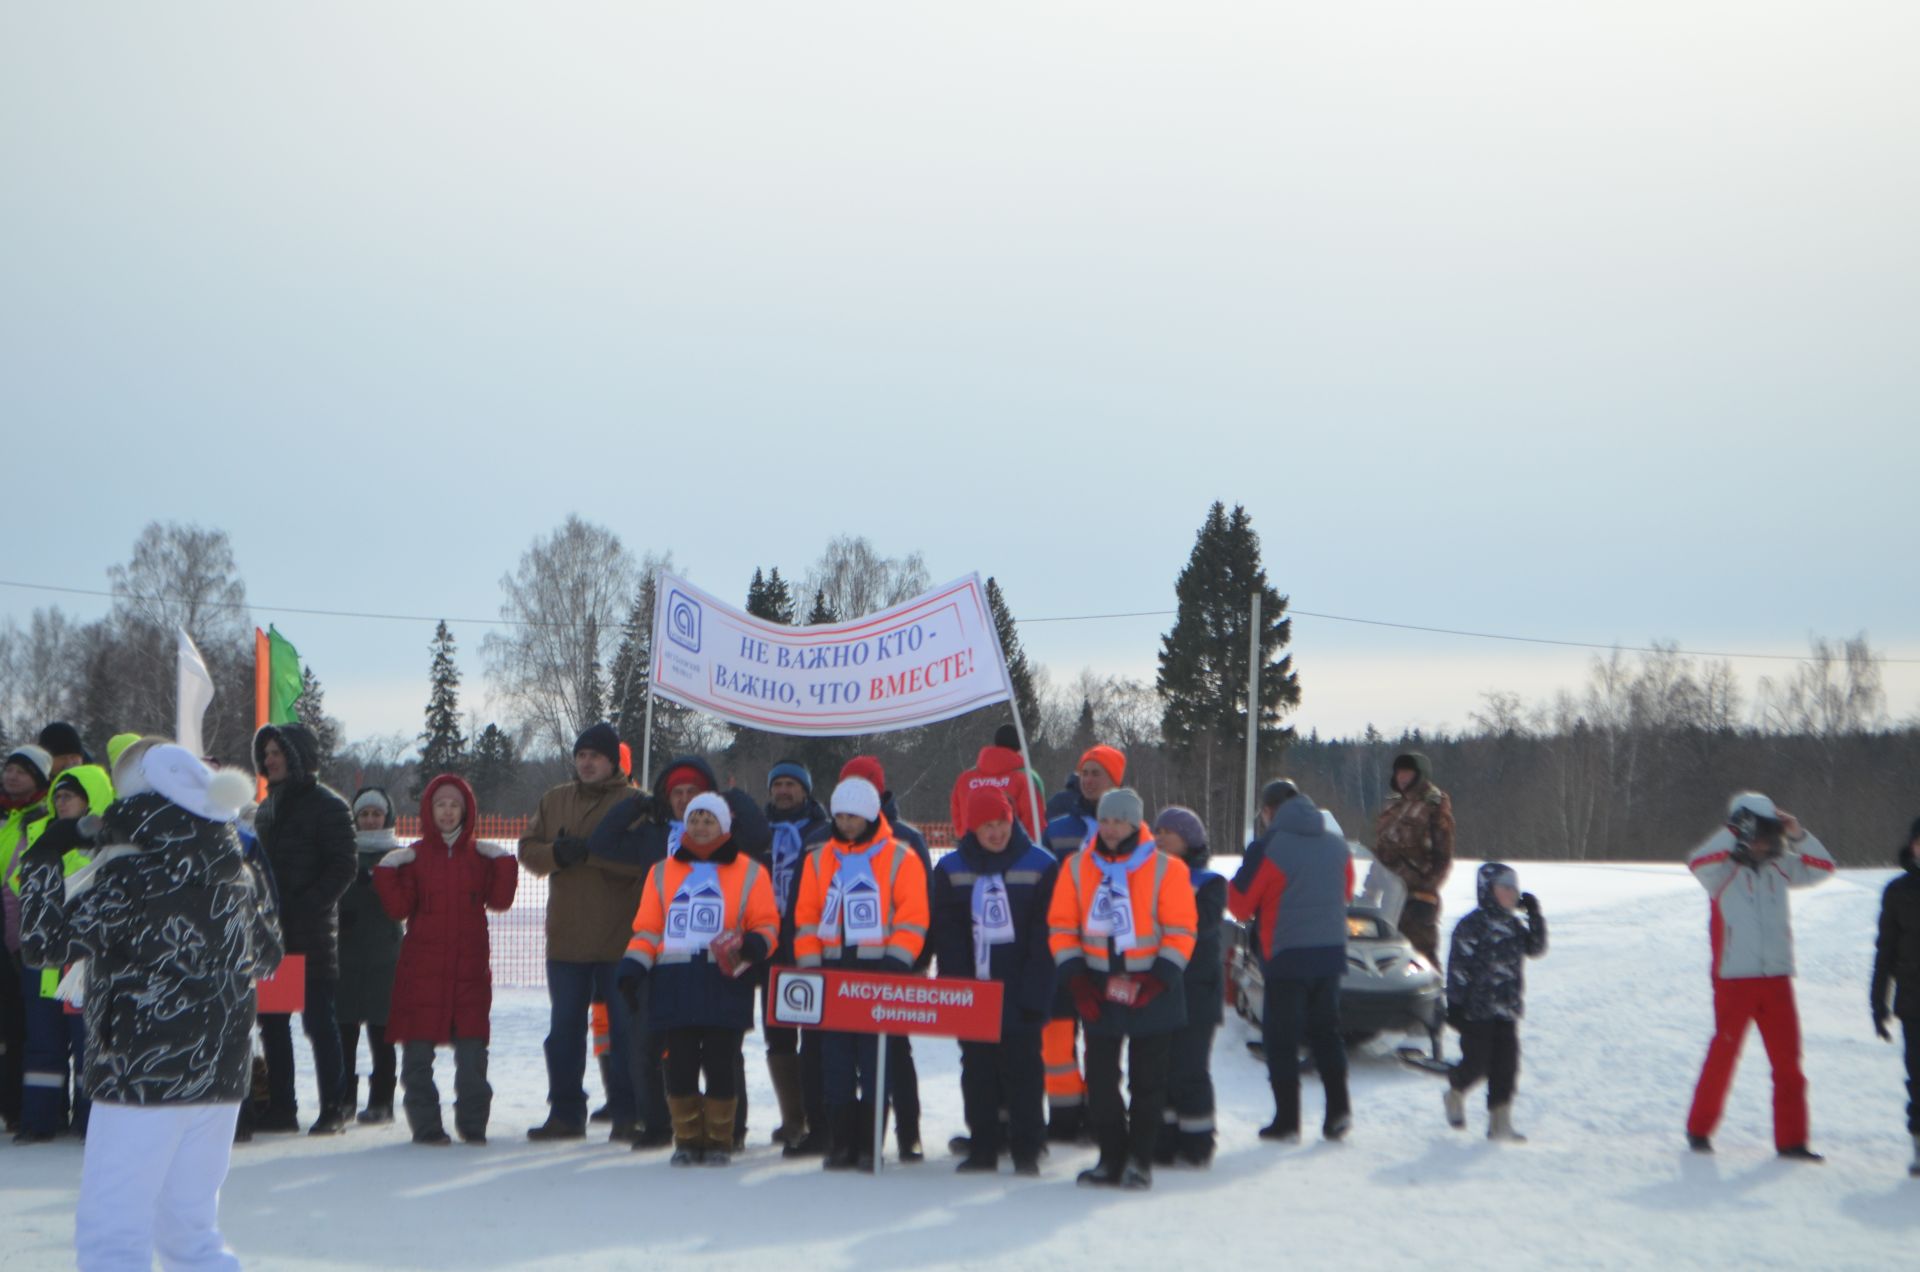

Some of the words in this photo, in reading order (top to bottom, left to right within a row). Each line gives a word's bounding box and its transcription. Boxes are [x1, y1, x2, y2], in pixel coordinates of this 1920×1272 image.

[740, 636, 769, 665] НЕ
[777, 639, 869, 670] ВАЖНО
[878, 624, 923, 661] КТО
[715, 664, 801, 707] ВАЖНО,
[808, 680, 860, 705] ЧТО
[869, 647, 975, 701] ВМЕСТЕ!
[838, 980, 973, 1007] АКСУБАЕВСКИЙ
[871, 1004, 937, 1024] филиал
